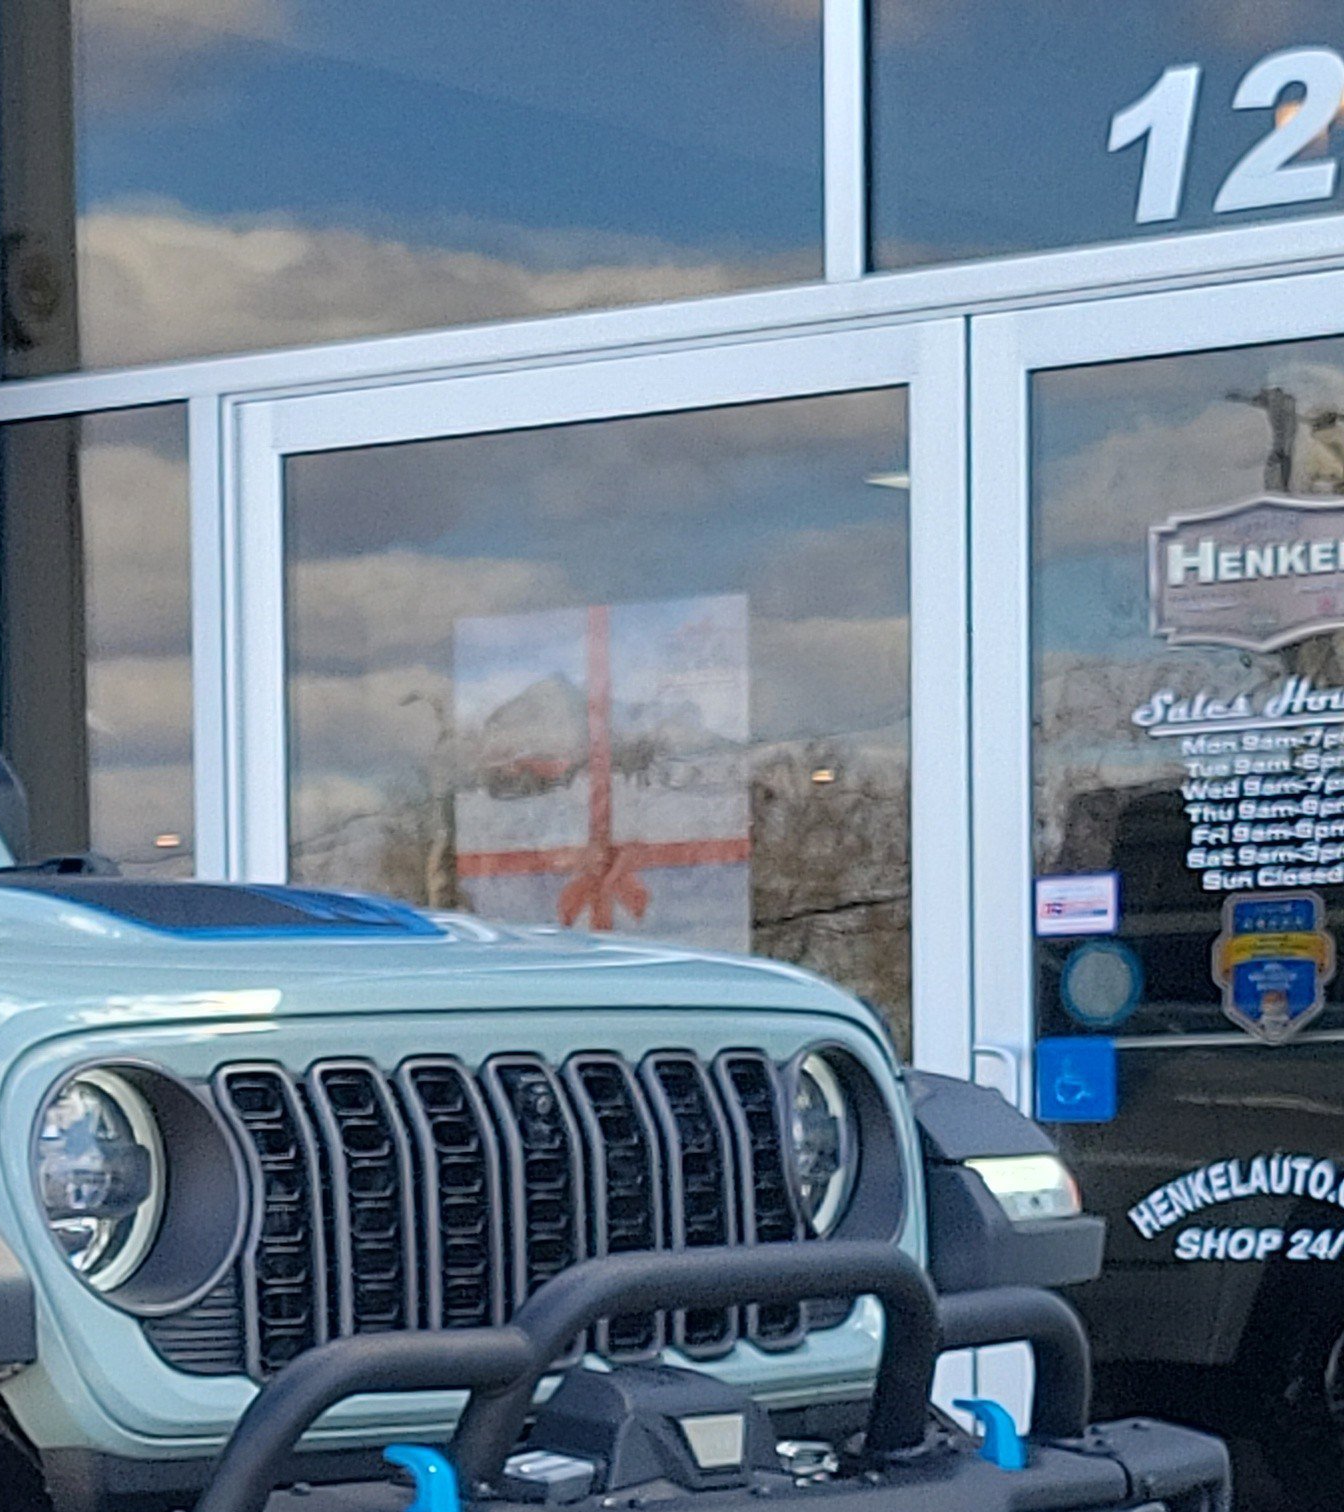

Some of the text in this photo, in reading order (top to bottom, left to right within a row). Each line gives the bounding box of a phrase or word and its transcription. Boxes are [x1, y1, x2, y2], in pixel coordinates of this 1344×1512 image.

[1108, 47, 1344, 224] 12
[1167, 539, 1344, 586] HENKE
[1131, 688, 1252, 727] Sales
[1181, 735, 1237, 756] Mon
[1183, 760, 1230, 779] Tue
[1181, 777, 1239, 800] Wed
[1186, 847, 1236, 869] Sat
[1202, 863, 1344, 891] Sun Closed
[1127, 1152, 1344, 1239] HENKELAUTO.
[1174, 1227, 1285, 1261] SHOP
